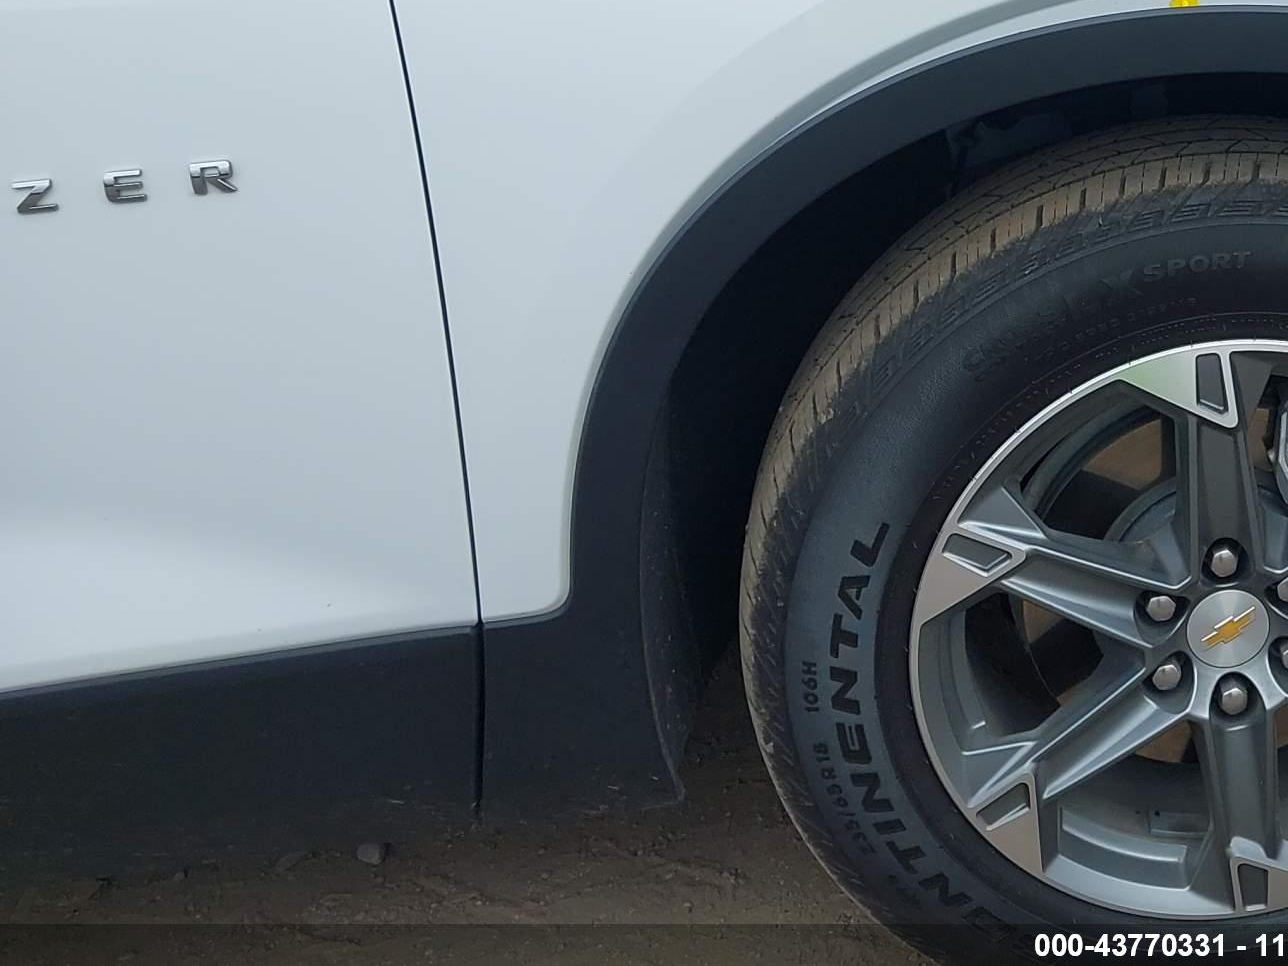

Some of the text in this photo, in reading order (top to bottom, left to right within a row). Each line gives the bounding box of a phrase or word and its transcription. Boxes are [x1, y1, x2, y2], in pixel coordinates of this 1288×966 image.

[11, 158, 239, 215] ZER
[1143, 249, 1253, 283] SPORT
[801, 660, 821, 714] 106H
[829, 522, 1032, 944] ONTINENTAL
